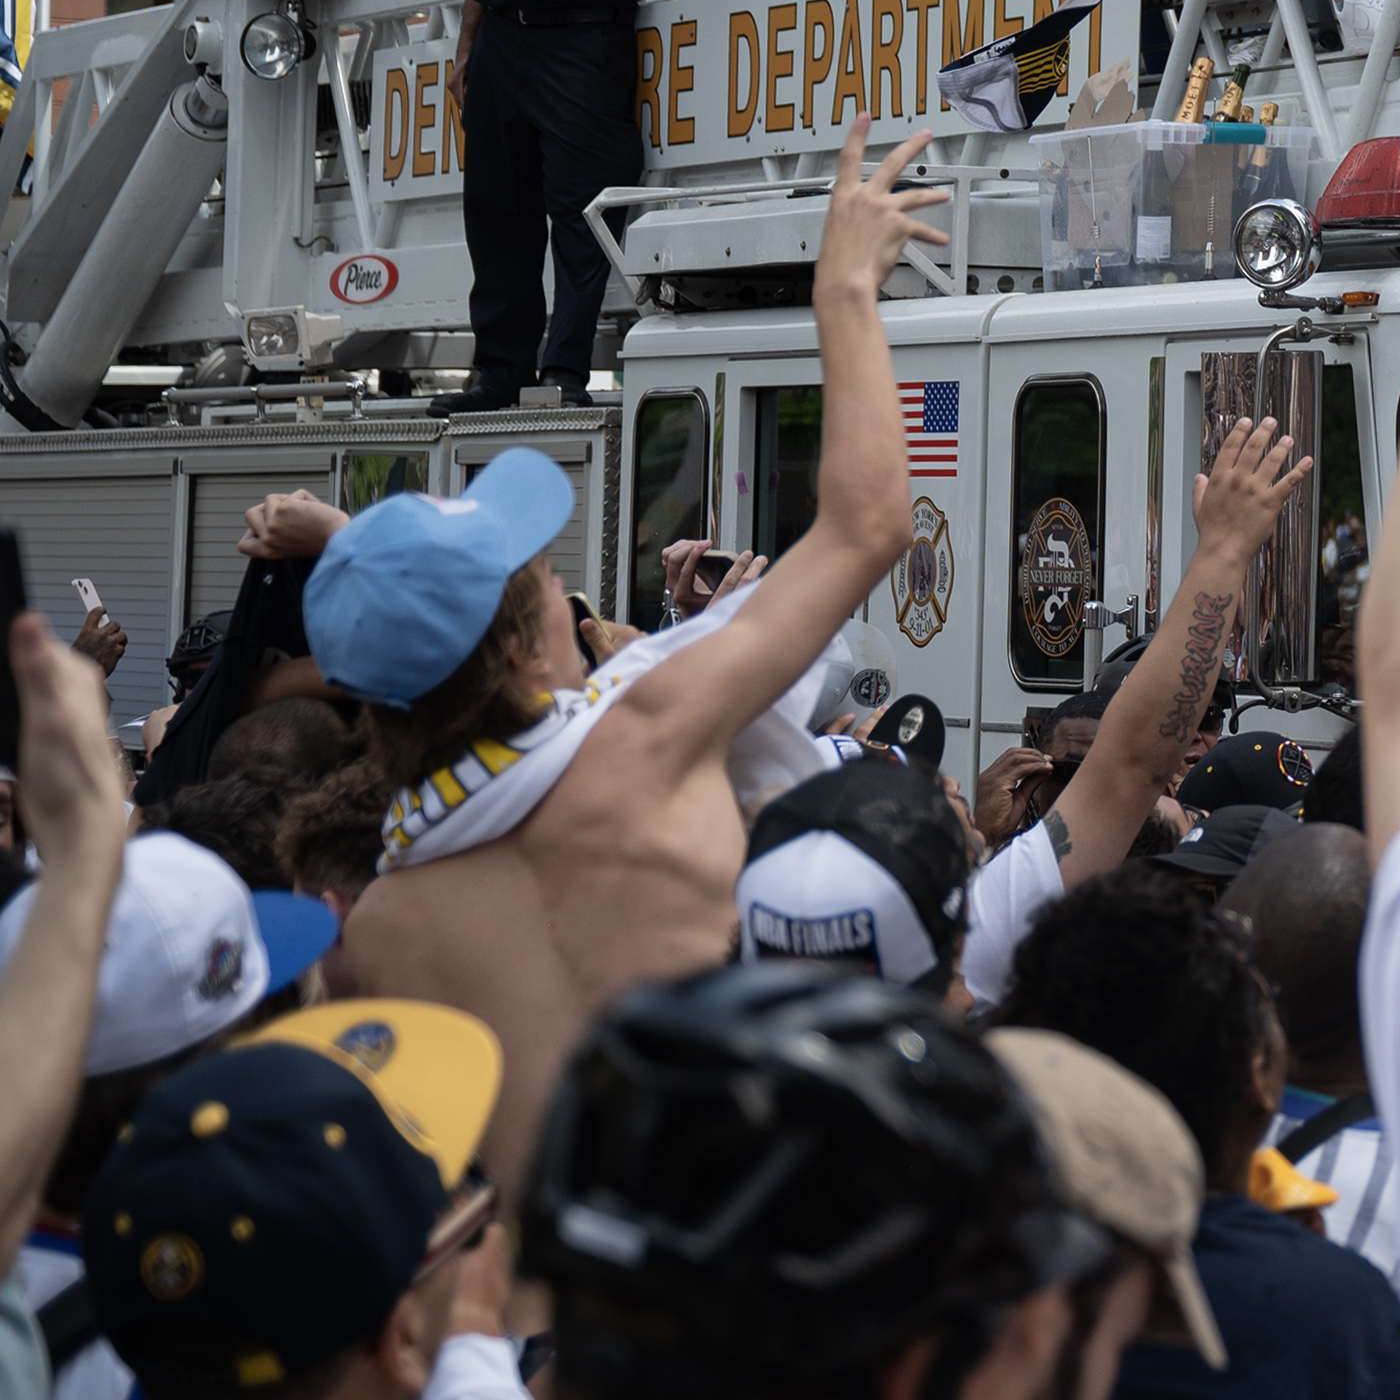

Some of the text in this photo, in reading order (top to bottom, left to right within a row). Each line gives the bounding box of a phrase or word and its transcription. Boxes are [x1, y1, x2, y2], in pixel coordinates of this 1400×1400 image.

[343, 262, 382, 297] Pierce
[1029, 569, 1084, 585] NEVER FORGET
[909, 616, 934, 637] 9-11-01
